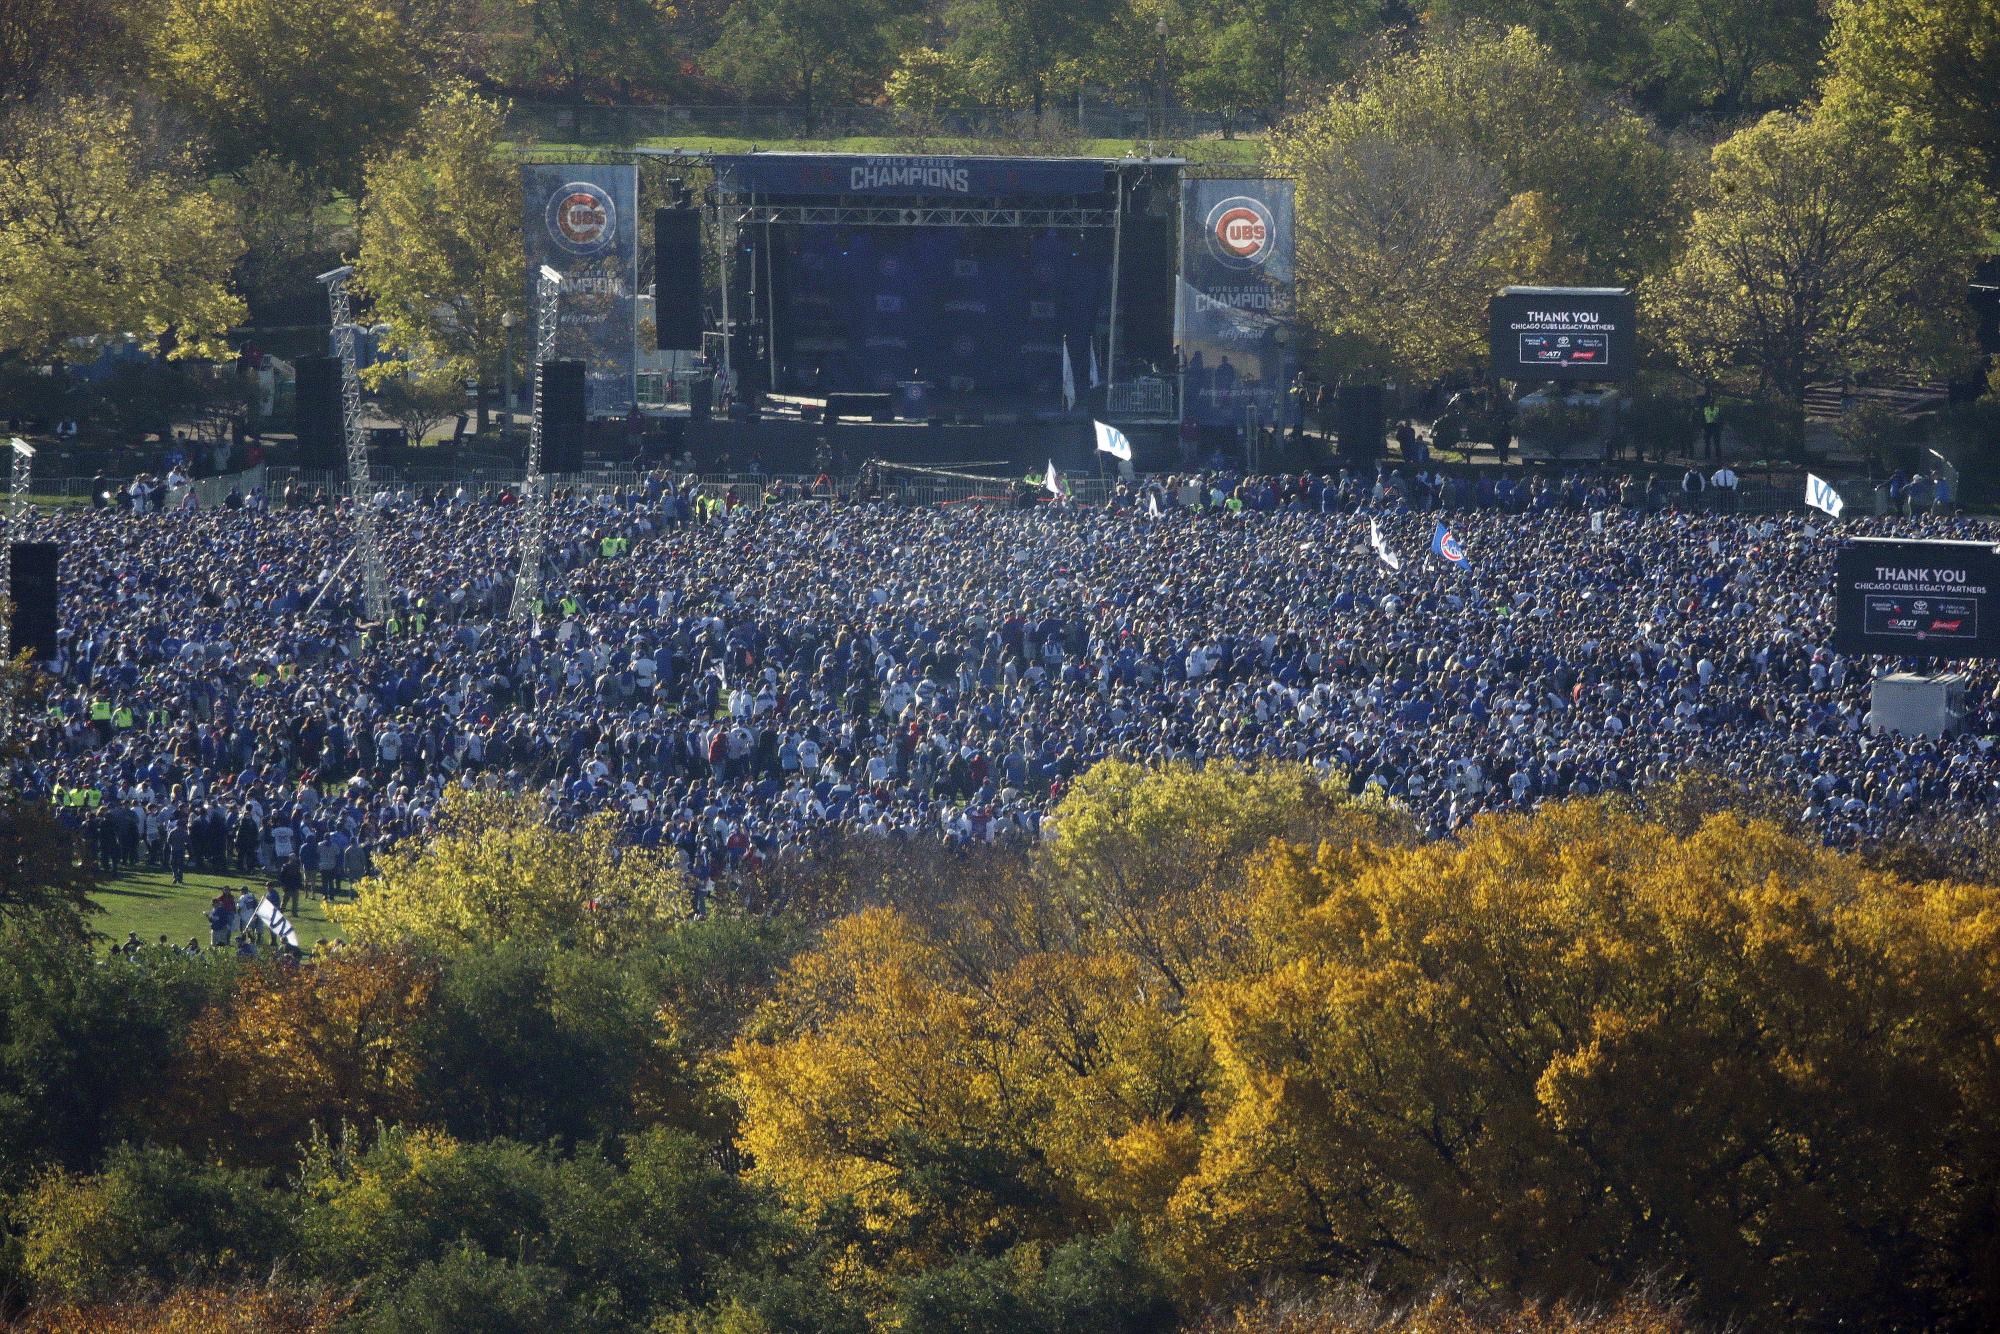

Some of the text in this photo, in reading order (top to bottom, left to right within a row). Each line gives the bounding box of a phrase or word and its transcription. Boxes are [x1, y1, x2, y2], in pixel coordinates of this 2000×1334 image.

[867, 157, 954, 167] WORLD SERIES
[850, 166, 969, 192] CHAMPIONS
[1527, 311, 1599, 323] THANK YOU
[1558, 323, 1583, 331] LEGACY
[1106, 427, 1129, 450] W
[1814, 479, 1840, 512] W
[1875, 567, 1966, 583] THANK YOU
[1854, 582, 1987, 594] CHICAGO CUBS LEGACY PARTNERS
[1898, 619, 1918, 627] ATI
[270, 907, 294, 937] W
